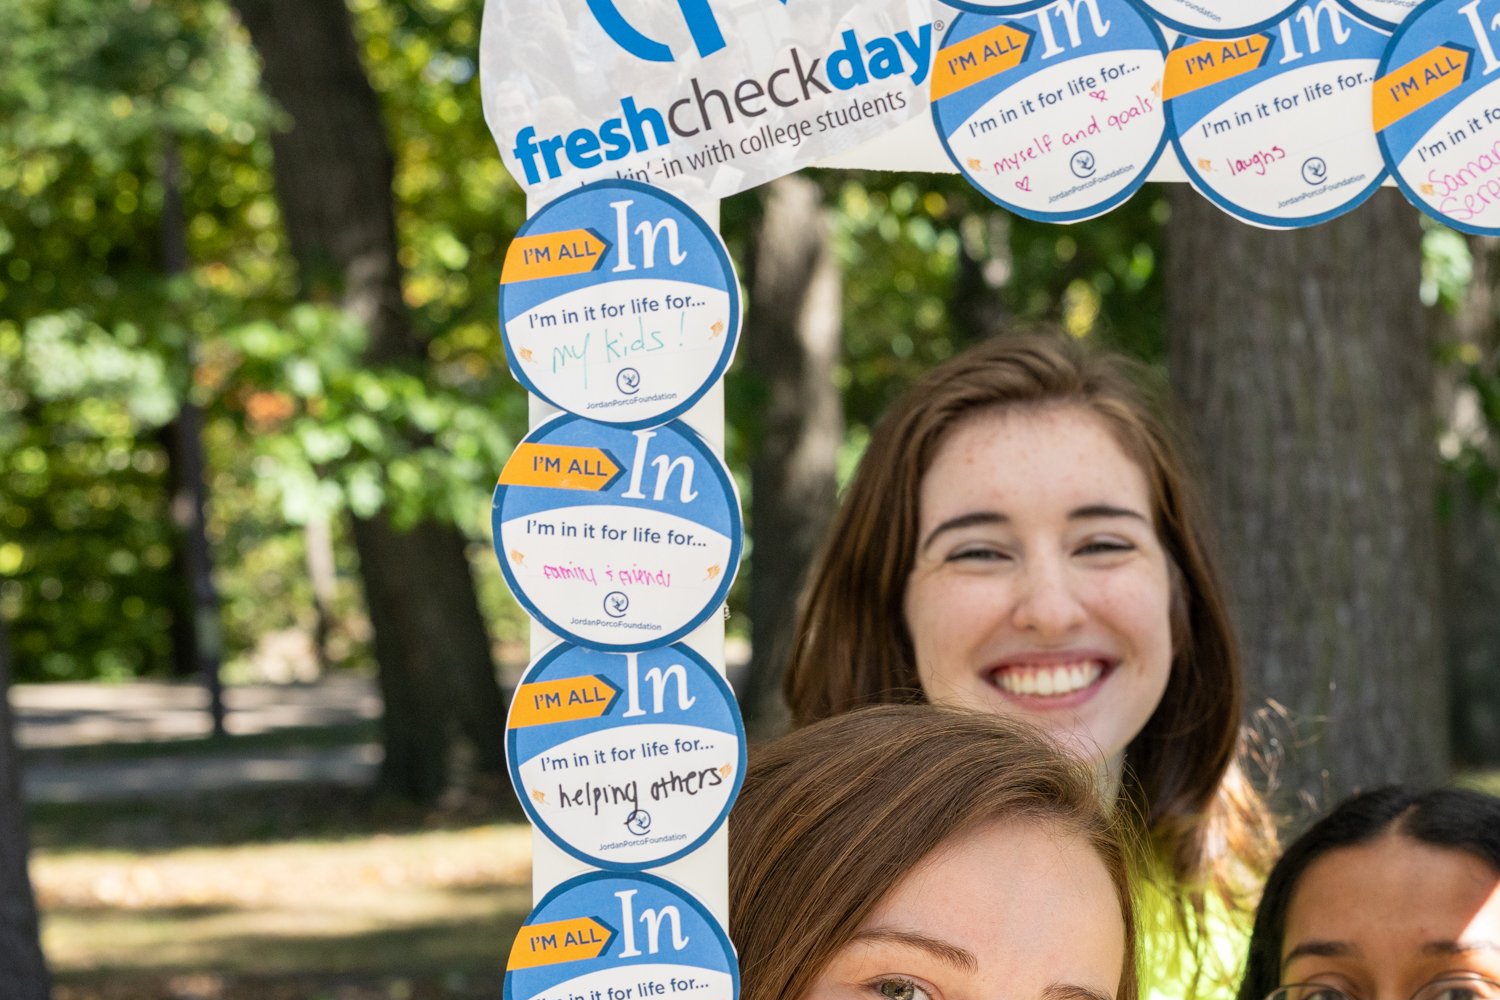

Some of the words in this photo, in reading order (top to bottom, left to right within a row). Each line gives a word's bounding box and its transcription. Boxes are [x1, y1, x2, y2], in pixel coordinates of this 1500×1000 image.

[686, 140, 735, 171] with
[739, 118, 813, 155] college
[817, 89, 907, 132] students
[994, 135, 1055, 176] myself
[1061, 120, 1101, 147] and
[1107, 97, 1154, 131] goals
[1226, 145, 1286, 176] laughs
[526, 520, 555, 536] I'm
[561, 522, 577, 538] in
[583, 524, 595, 539] it
[601, 525, 627, 541] for
[633, 527, 661, 544] life
[668, 529, 707, 547] for...
[534, 691, 561, 710] I'M
[567, 687, 606, 705] ALL
[622, 652, 697, 718] In
[558, 780, 639, 826] helping
[650, 766, 723, 801] others
